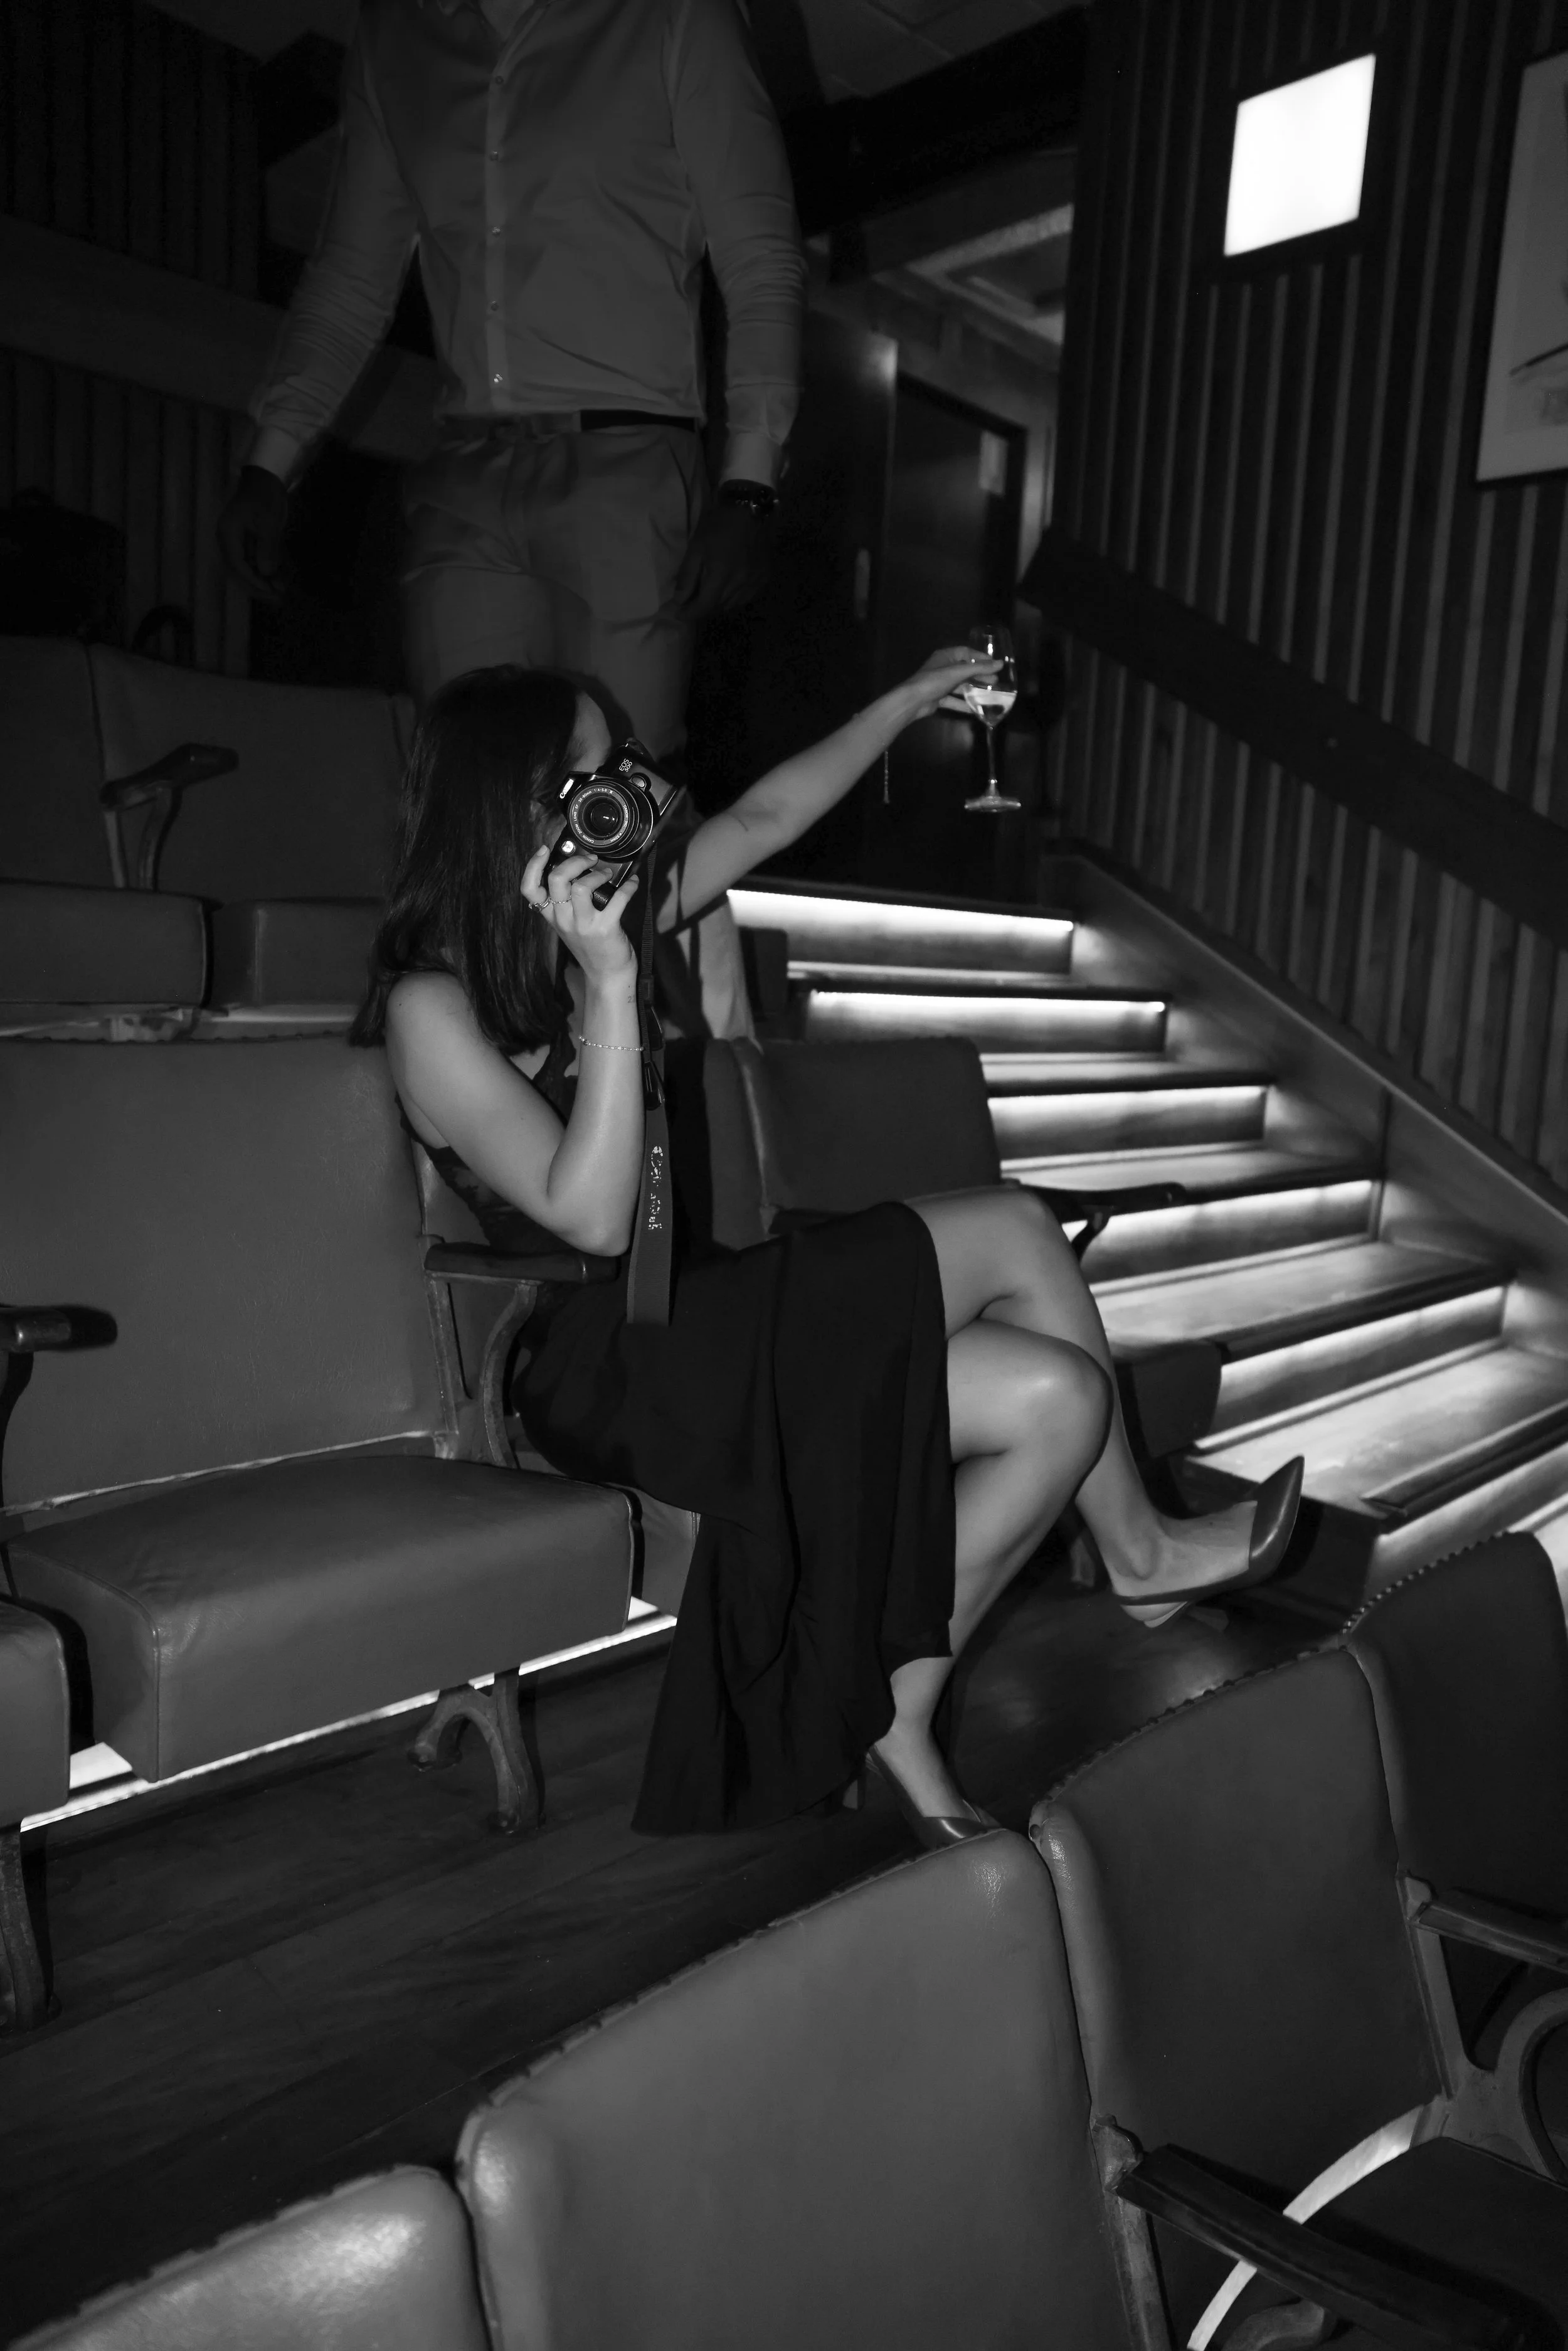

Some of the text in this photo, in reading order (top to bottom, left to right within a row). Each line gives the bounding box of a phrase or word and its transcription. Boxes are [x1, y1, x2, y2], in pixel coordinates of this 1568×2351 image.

[619, 758, 629, 772] EOS
[625, 762, 633, 772] 500
[559, 778, 574, 799] Can
[583, 835, 595, 843] CANON
